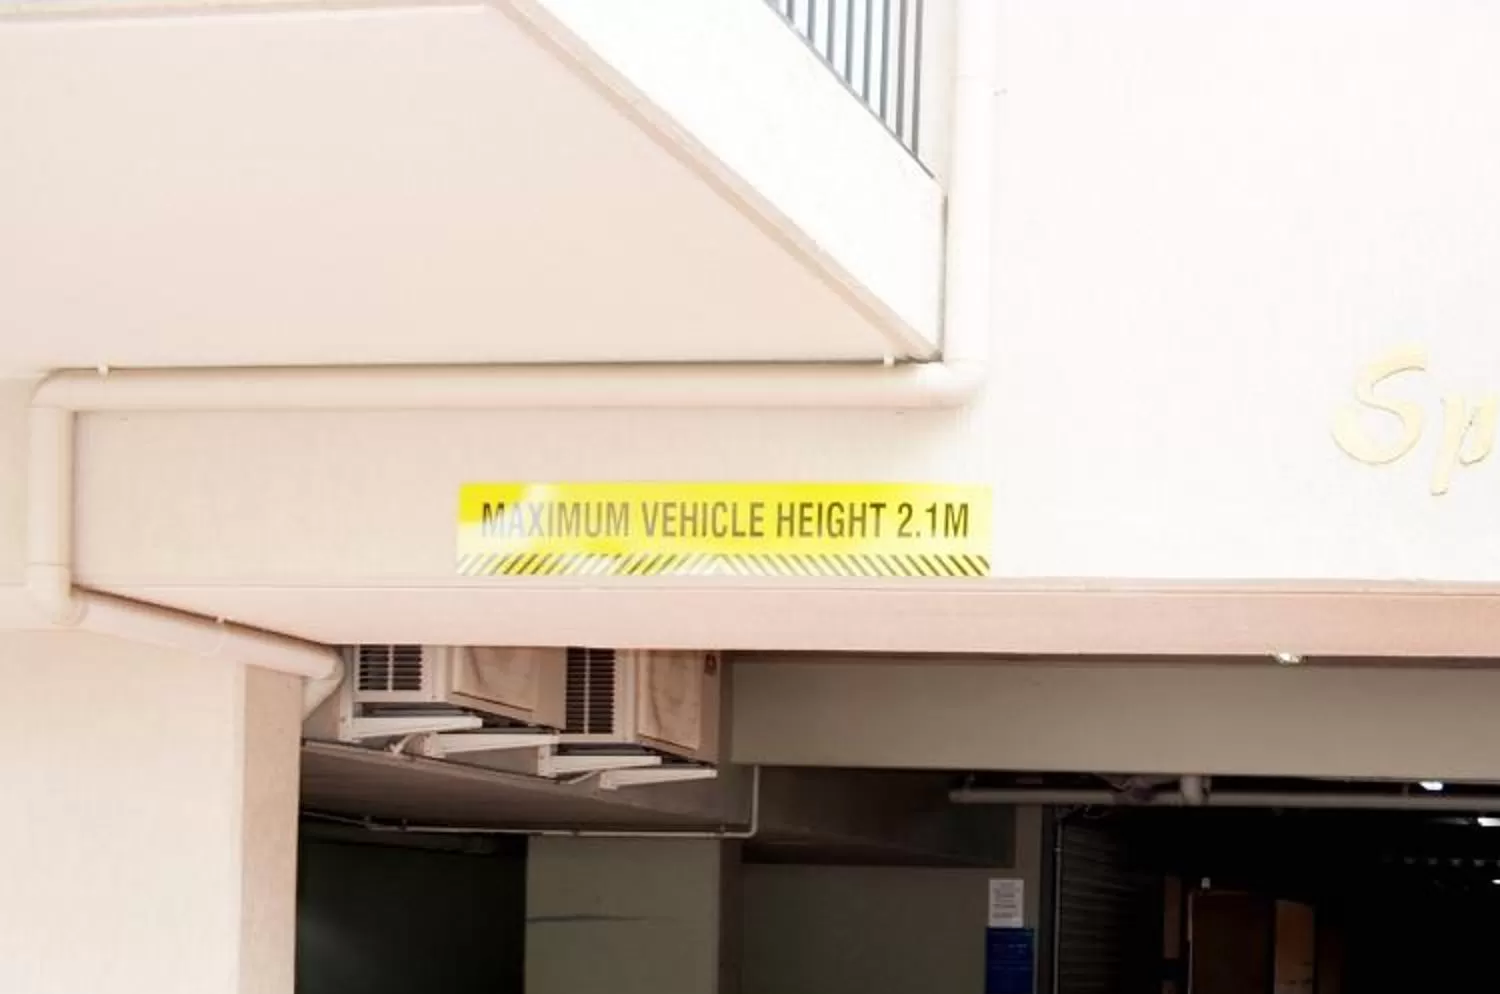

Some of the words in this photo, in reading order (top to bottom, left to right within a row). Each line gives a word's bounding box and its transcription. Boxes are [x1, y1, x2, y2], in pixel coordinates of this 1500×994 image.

[481, 501, 630, 538] MAXIMUM
[641, 501, 764, 539] VEHICLE
[776, 502, 886, 539] HEIGHT
[897, 502, 969, 539] 2.1M
